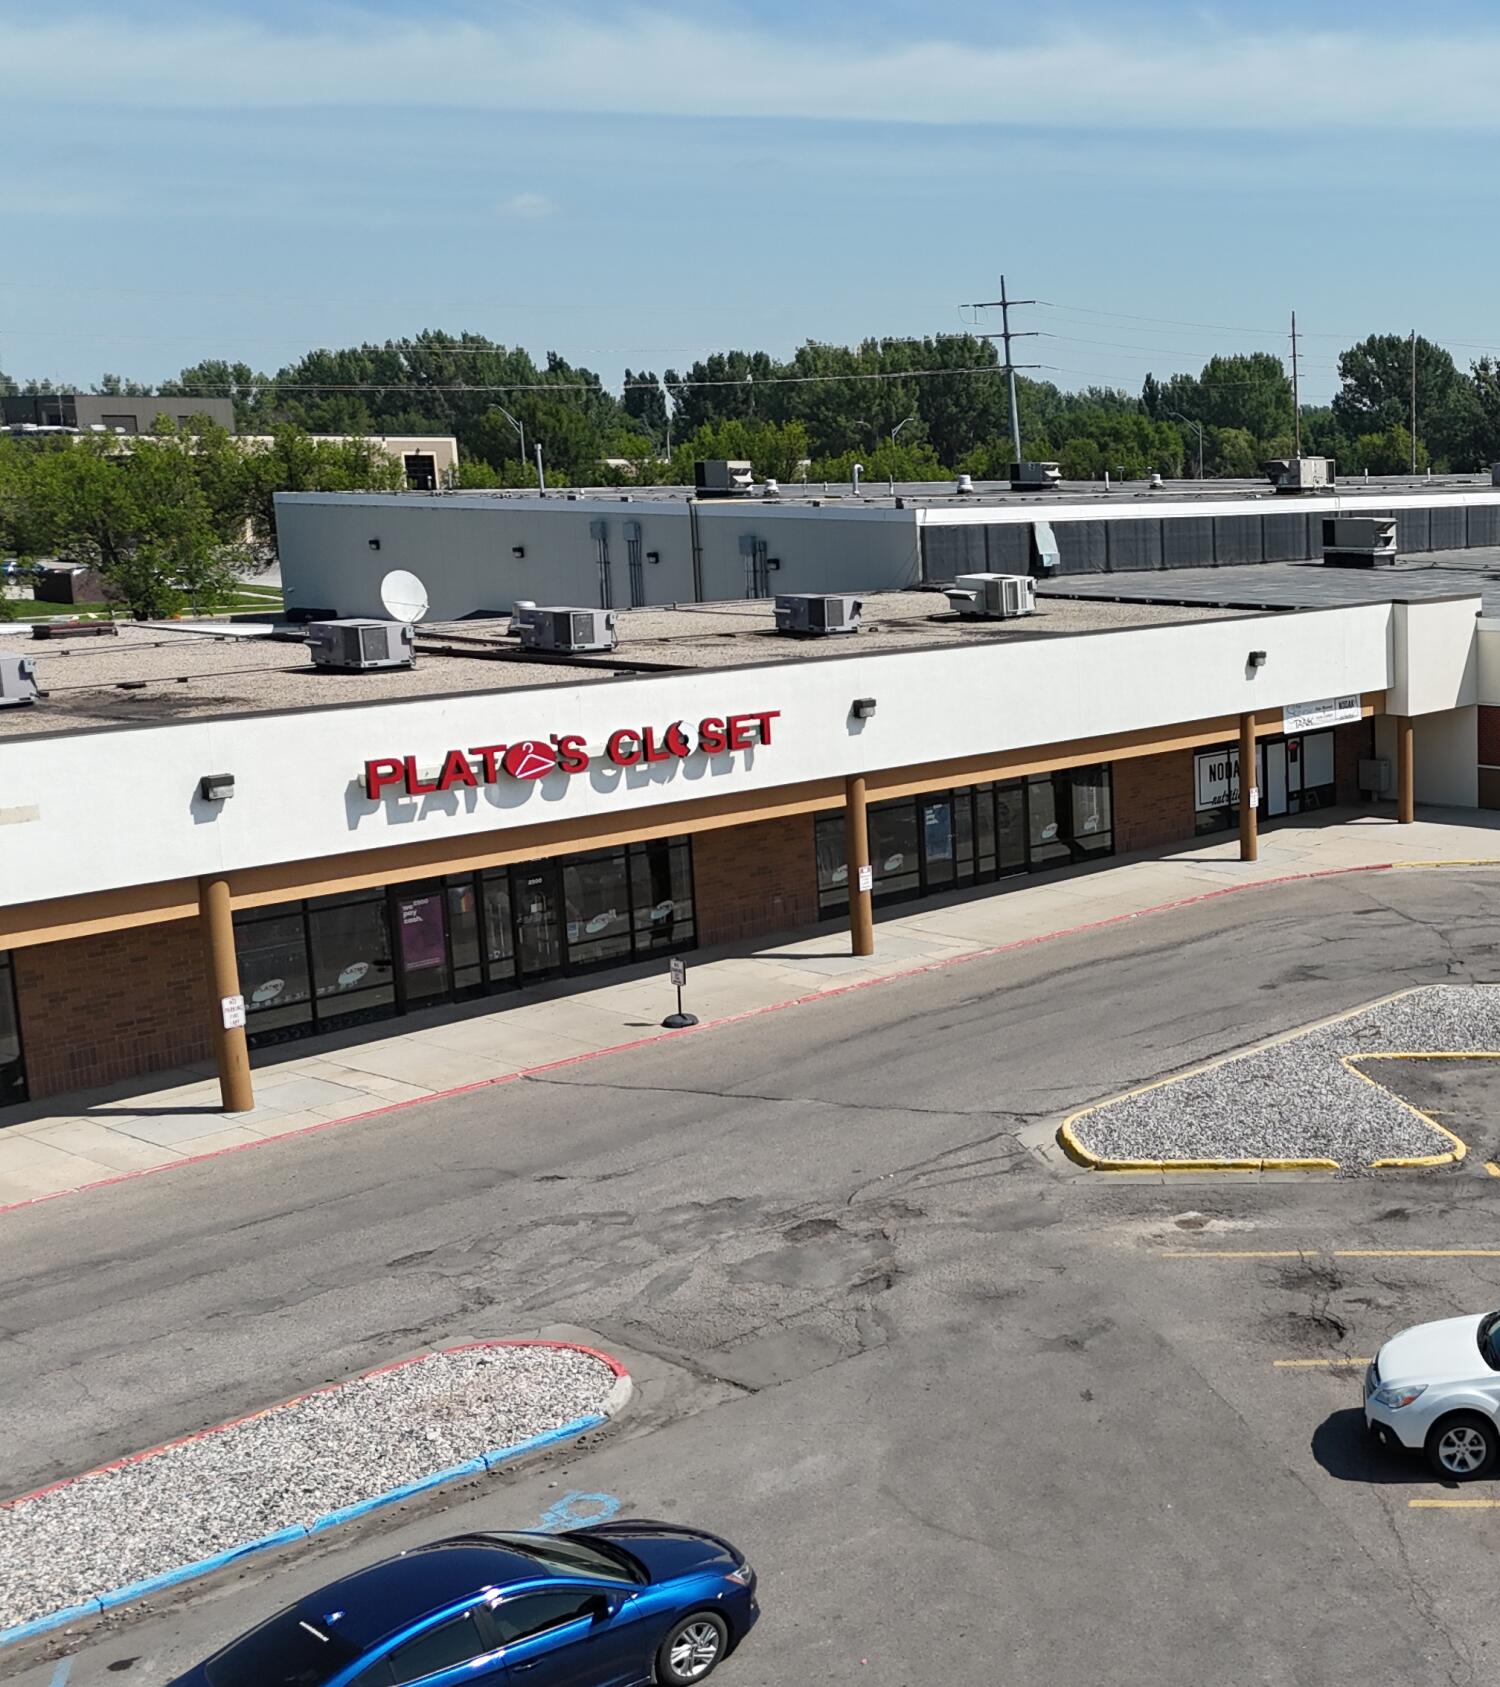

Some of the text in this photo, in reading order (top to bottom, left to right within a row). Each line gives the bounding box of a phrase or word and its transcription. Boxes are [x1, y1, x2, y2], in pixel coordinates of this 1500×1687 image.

[367, 710, 781, 799] PLATO'S CLOSET
[1209, 760, 1239, 783] NODA
